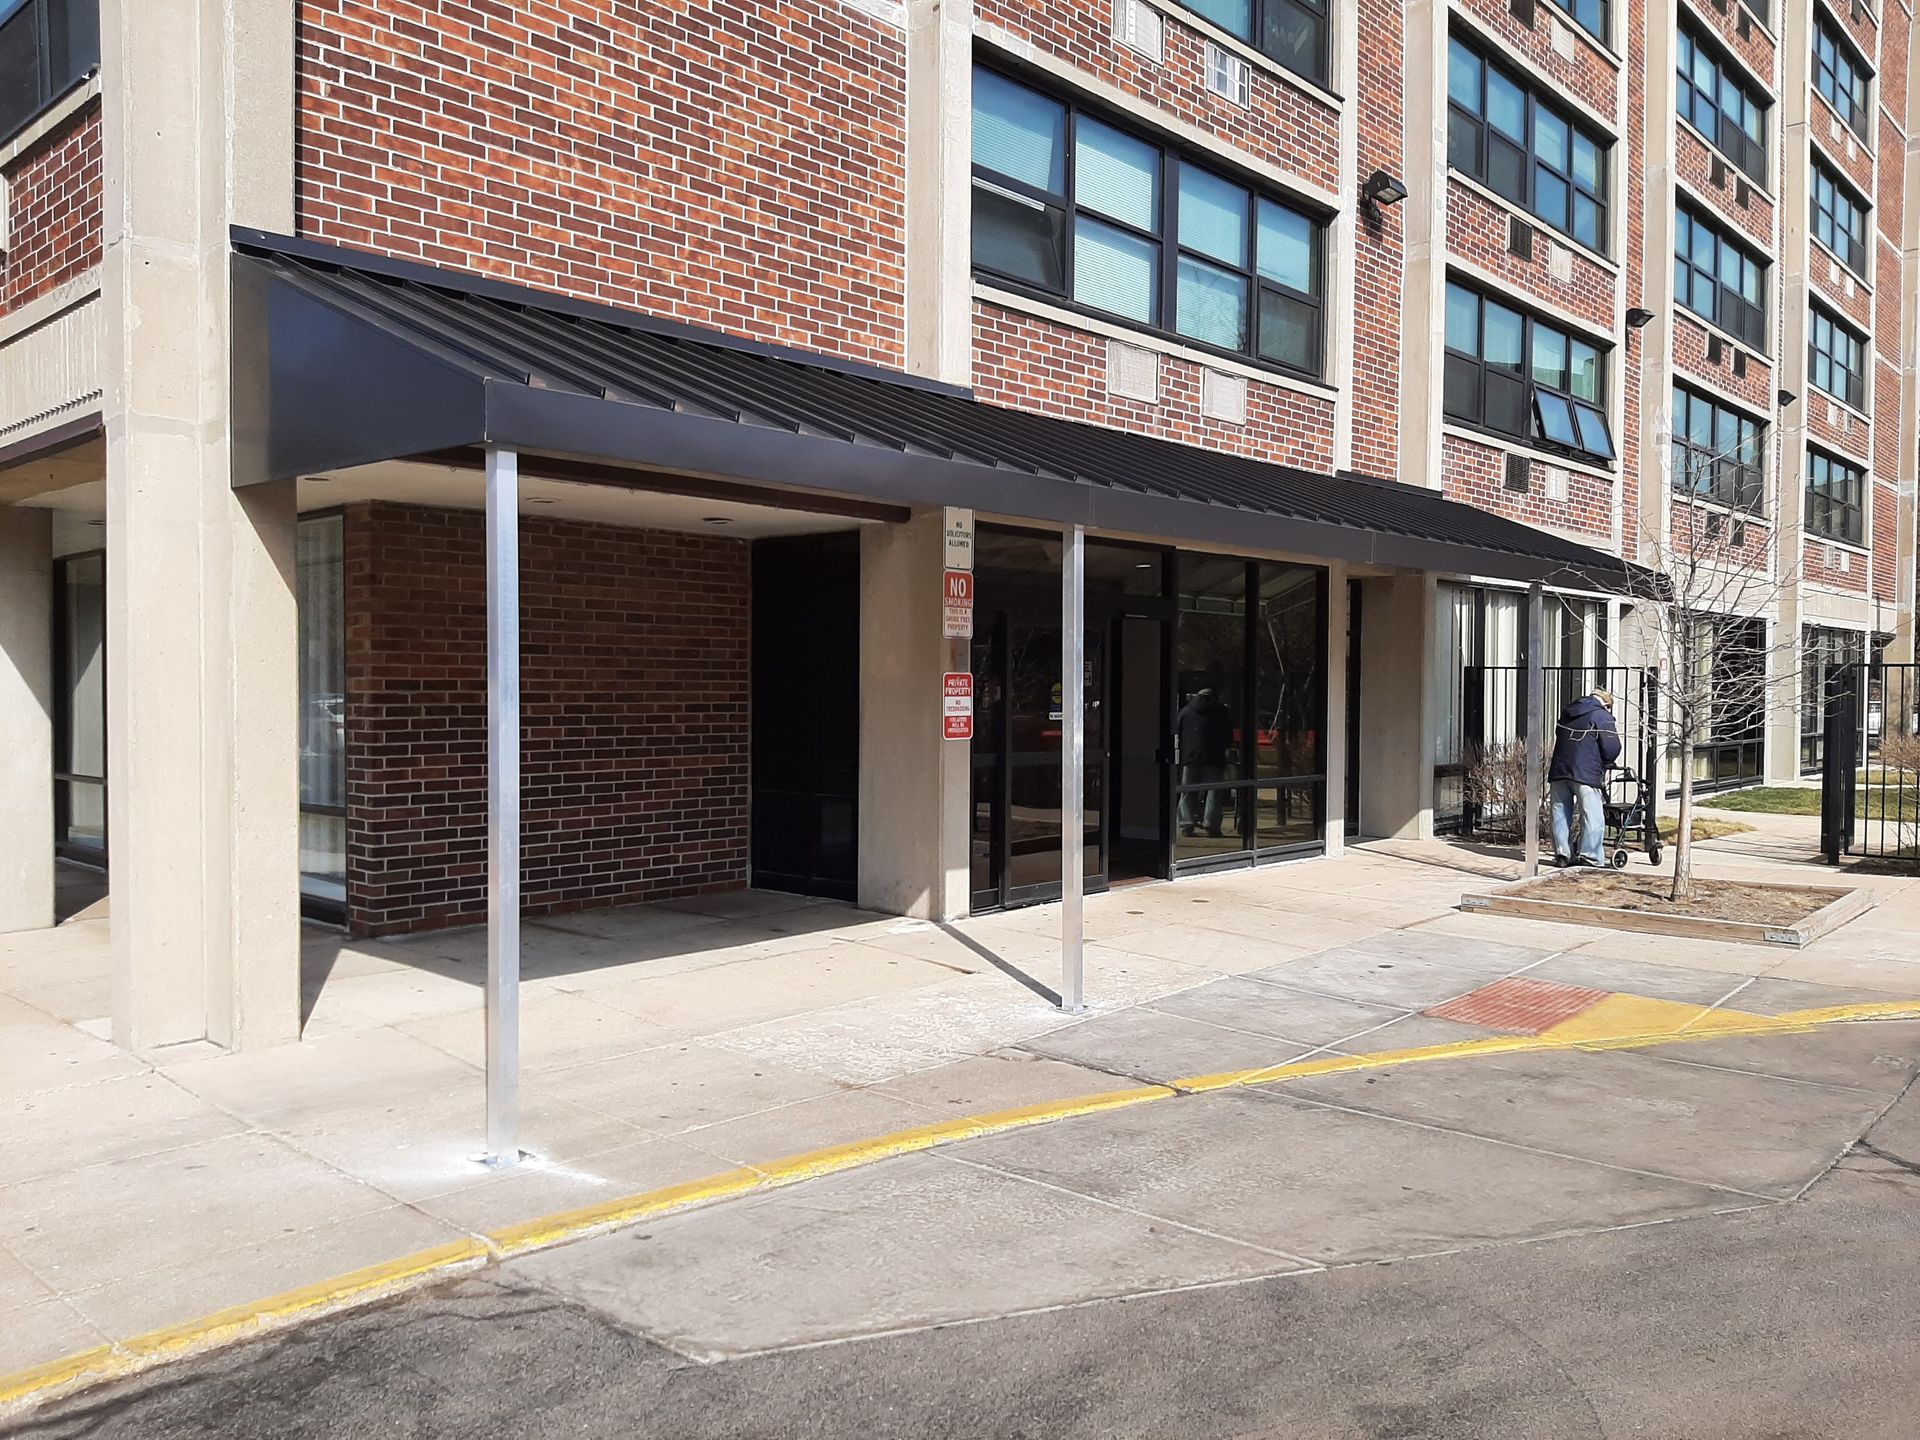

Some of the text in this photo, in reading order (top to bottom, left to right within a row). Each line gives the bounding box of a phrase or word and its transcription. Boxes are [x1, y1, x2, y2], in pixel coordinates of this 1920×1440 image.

[949, 540, 969, 548] ALLOWED
[950, 576, 966, 597] NO
[945, 597, 972, 608] SMOKING
[948, 623, 968, 631] PROPERTY
[948, 679, 968, 687] PRIVATE
[945, 687, 970, 695] PROPERTY
